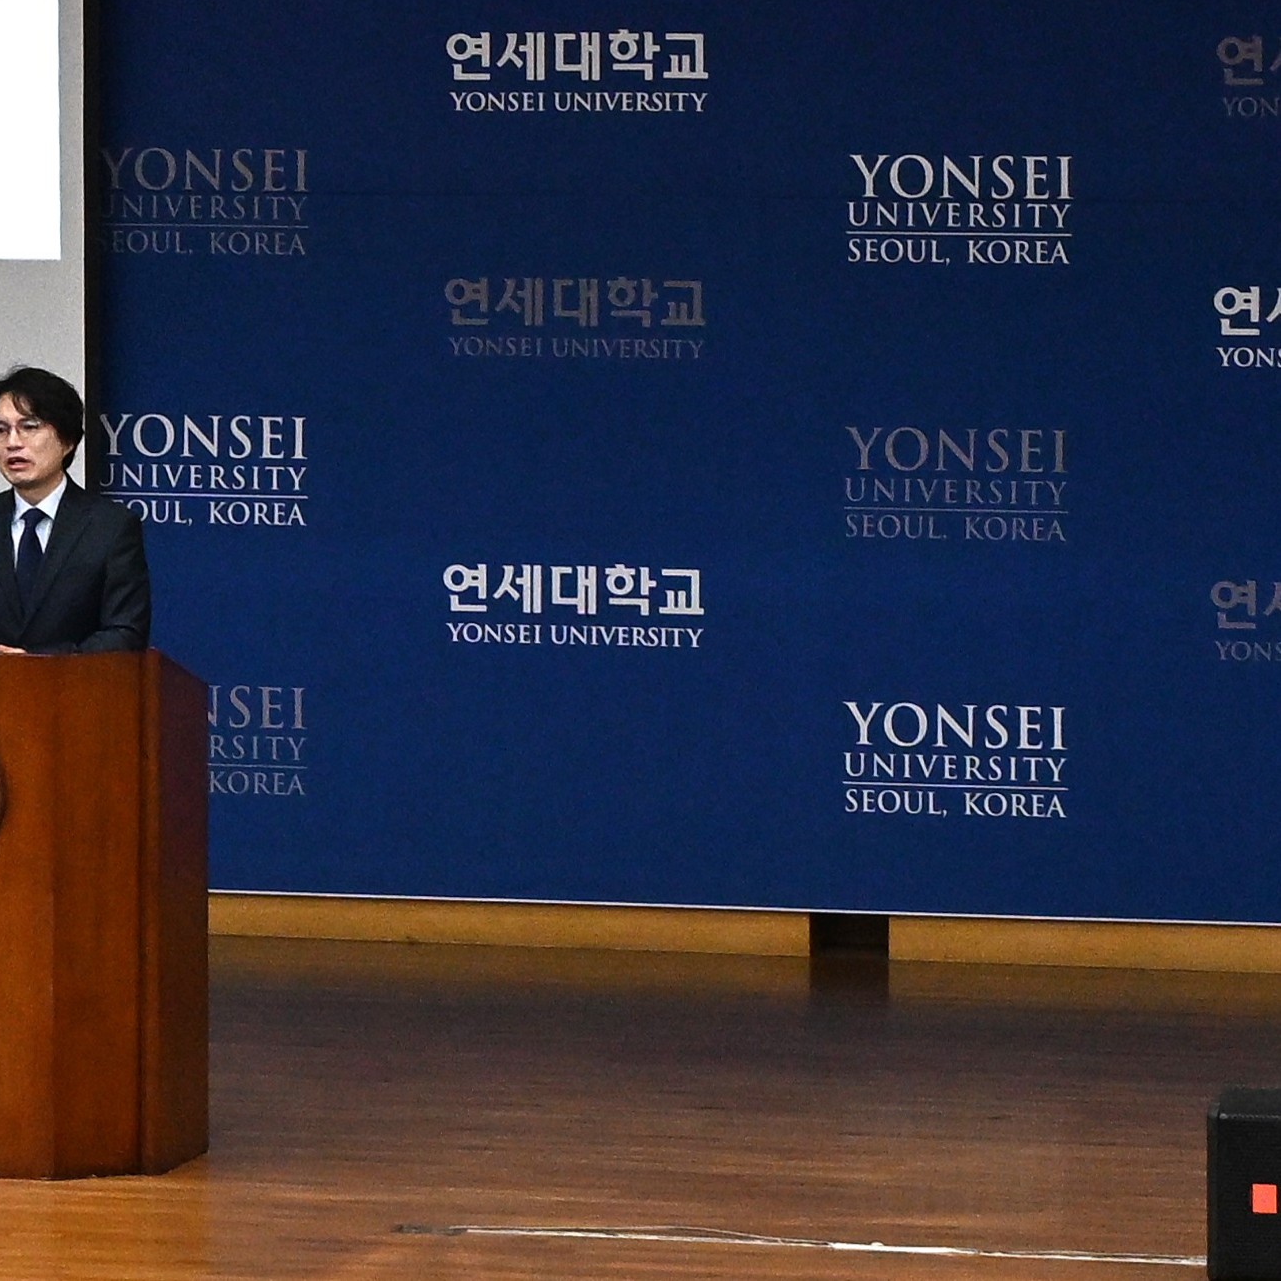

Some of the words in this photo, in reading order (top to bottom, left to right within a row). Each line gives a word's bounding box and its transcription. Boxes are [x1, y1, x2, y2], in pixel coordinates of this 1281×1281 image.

[445, 28, 709, 81] 연세대학교
[1216, 35, 1281, 86] 연
[449, 91, 545, 112] YONSEI
[553, 91, 708, 113] UNIVERSITY
[103, 147, 309, 192] YONSEI
[849, 154, 1072, 200] YONSEI
[848, 201, 1071, 229] UNIVERSITY
[107, 229, 194, 256] EOUL,
[209, 230, 306, 256] KOREA
[847, 238, 951, 265] SEOUL,
[967, 239, 1070, 265] KOREA
[443, 276, 706, 328] 연세대학교
[1214, 286, 1281, 336] 연
[448, 335, 542, 357] YONSEI
[551, 337, 704, 360] UNIVERSITY
[100, 413, 307, 460] YONSEI
[845, 426, 1066, 473] YONSEI
[844, 476, 1067, 506] UNIVERSITY
[114, 498, 193, 527] OUL,
[209, 501, 307, 527] KOREA
[965, 516, 1067, 542] KOREA
[442, 563, 705, 616] 연세대학교
[446, 622, 541, 645] YONSEI
[550, 624, 704, 648] UNIVERSITY
[843, 701, 1066, 751] YONSEI
[843, 751, 1067, 783] UNIVERSITY
[209, 770, 306, 796] KOREA
[844, 788, 948, 817] SEOUL,
[963, 791, 1067, 819] KOREA
